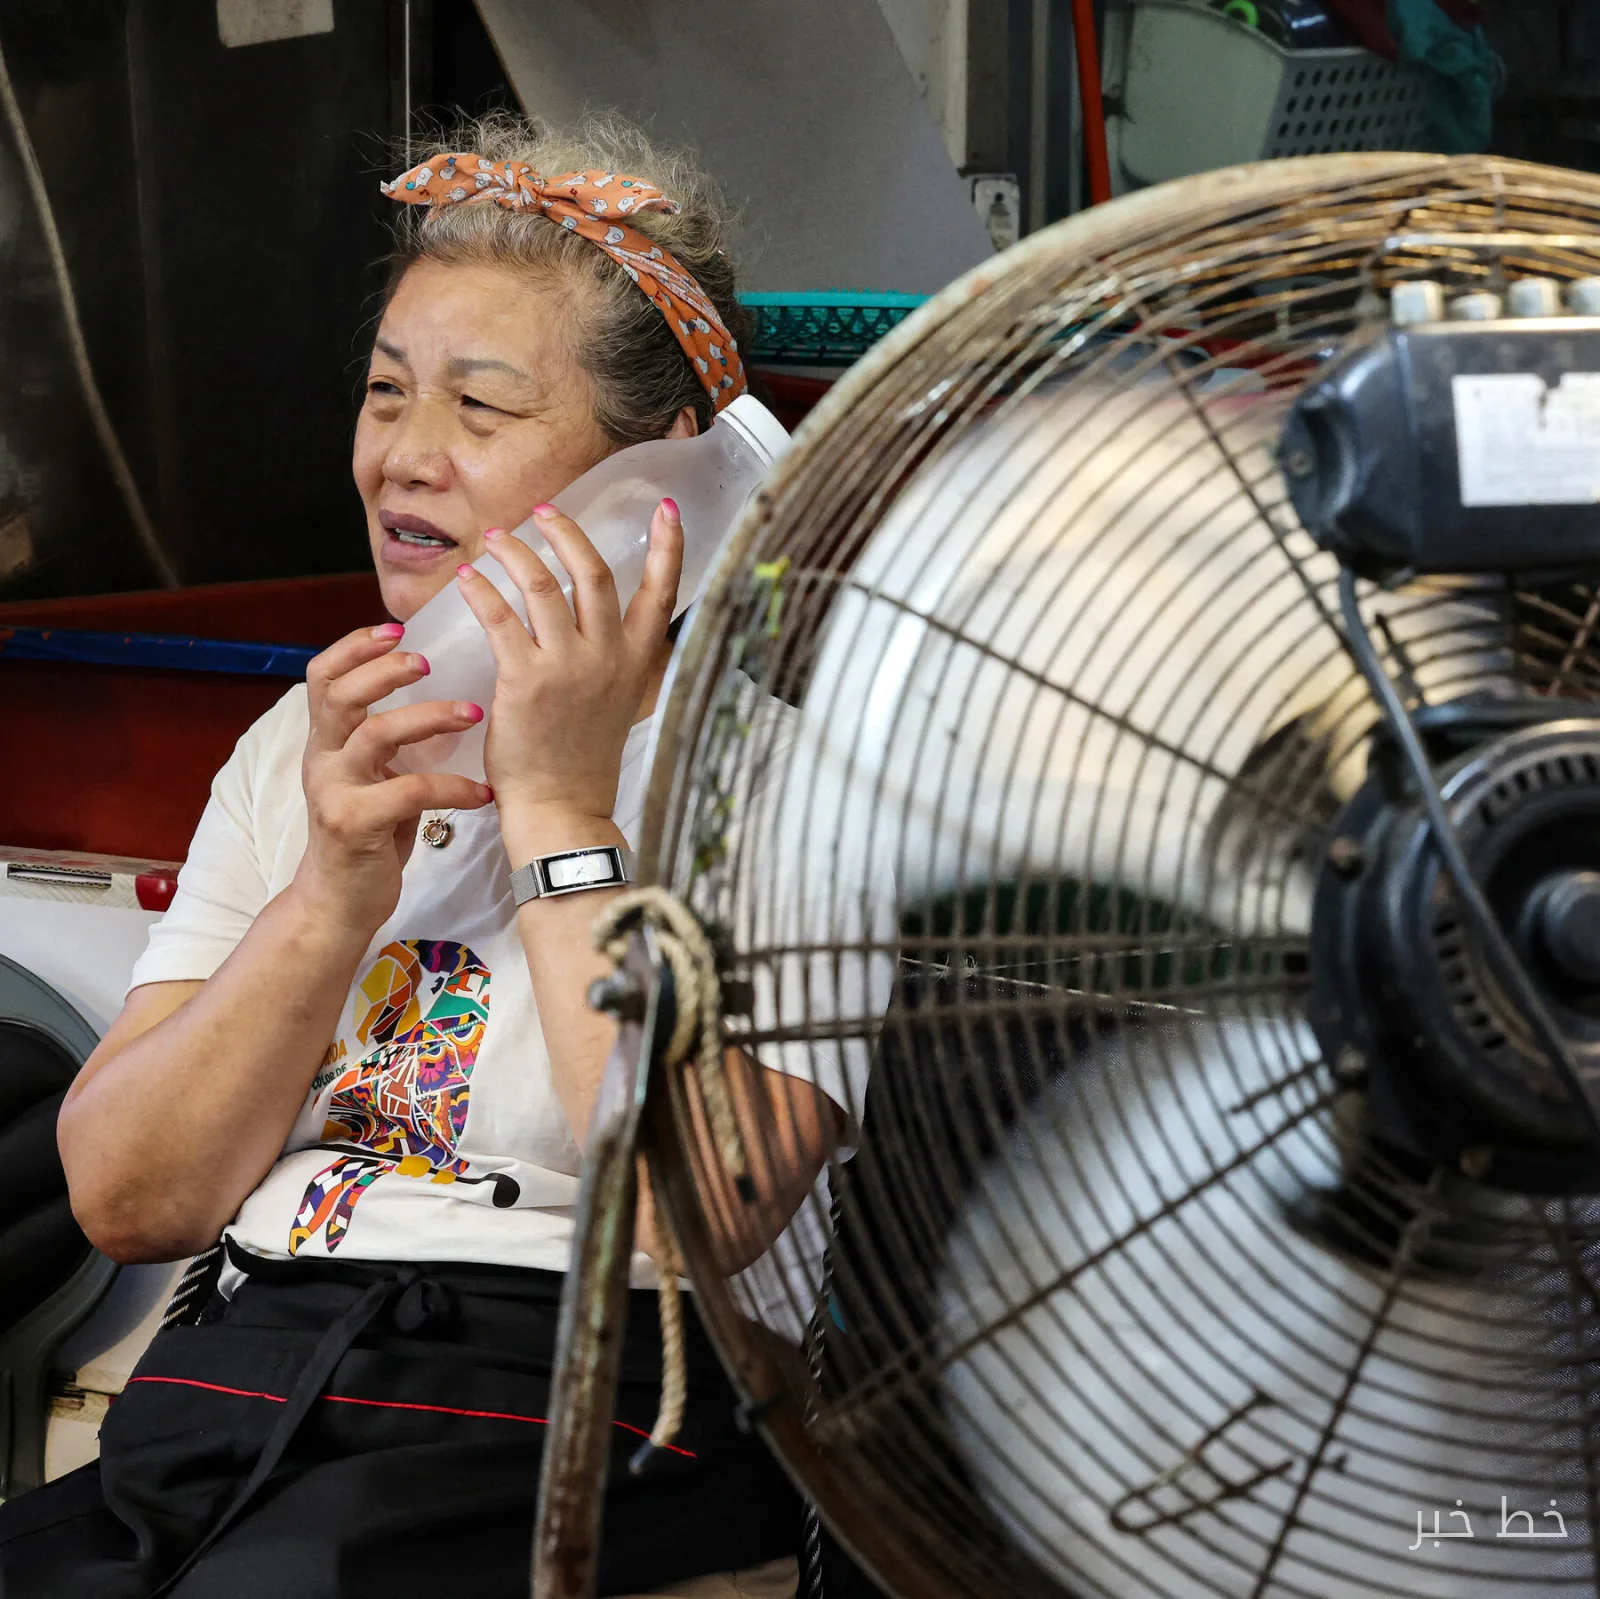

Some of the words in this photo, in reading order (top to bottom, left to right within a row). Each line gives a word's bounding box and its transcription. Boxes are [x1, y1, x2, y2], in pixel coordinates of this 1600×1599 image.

[322, 1038, 348, 1068] ODA
[312, 1071, 335, 1090] COLOR
[335, 1062, 348, 1076] DE
